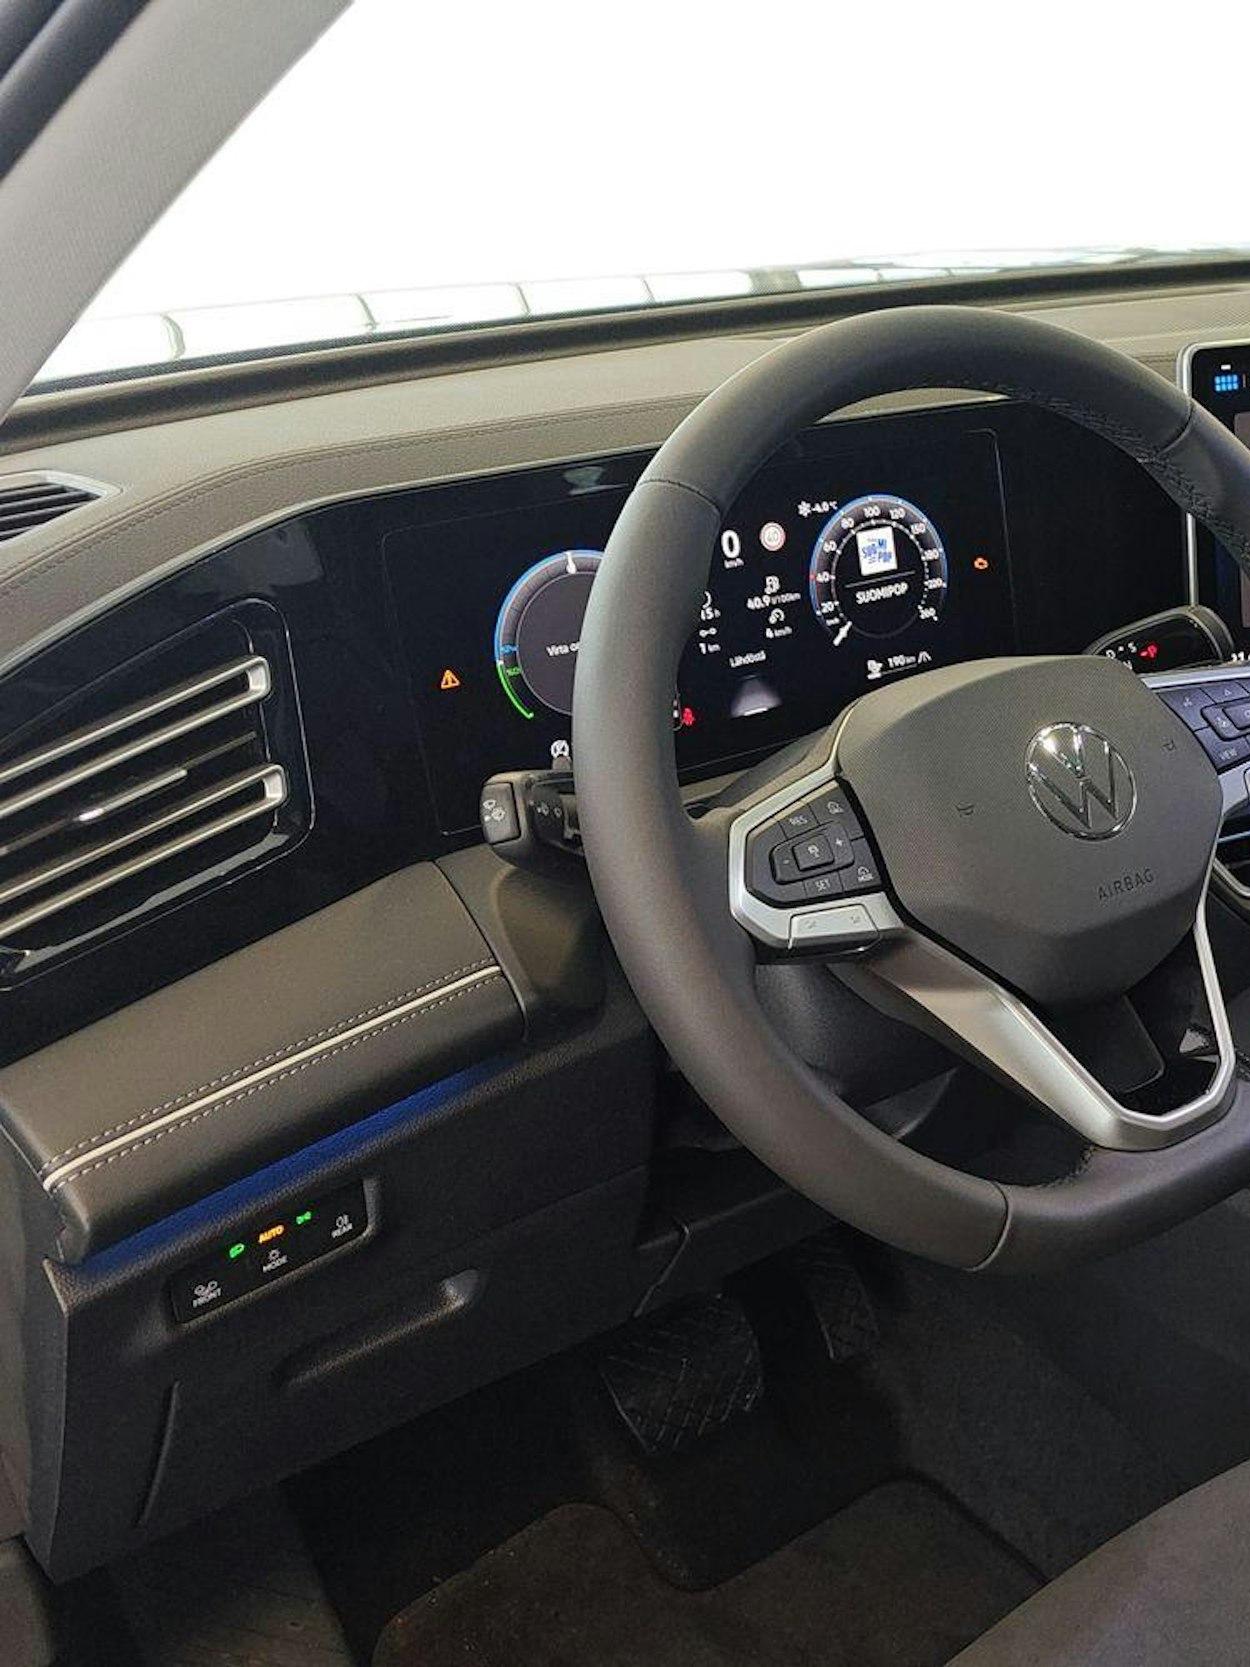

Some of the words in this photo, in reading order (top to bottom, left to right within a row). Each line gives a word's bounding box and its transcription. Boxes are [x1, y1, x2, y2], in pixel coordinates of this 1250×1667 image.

[863, 505, 881, 517] 100
[889, 507, 906, 520] 120
[720, 529, 742, 559] 0
[823, 540, 837, 553] 60
[855, 582, 909, 605] SUOMIPOP
[747, 594, 771, 611] 40.9
[821, 601, 835, 614] 20
[545, 644, 569, 657] Virta
[887, 654, 905, 668] 190
[789, 815, 808, 825] RES
[815, 879, 831, 891] SET
[1098, 868, 1154, 900] AIRBAG
[258, 1224, 285, 1244] AUTO
[262, 1254, 288, 1273] MODE
[192, 1288, 222, 1308] FRONT
